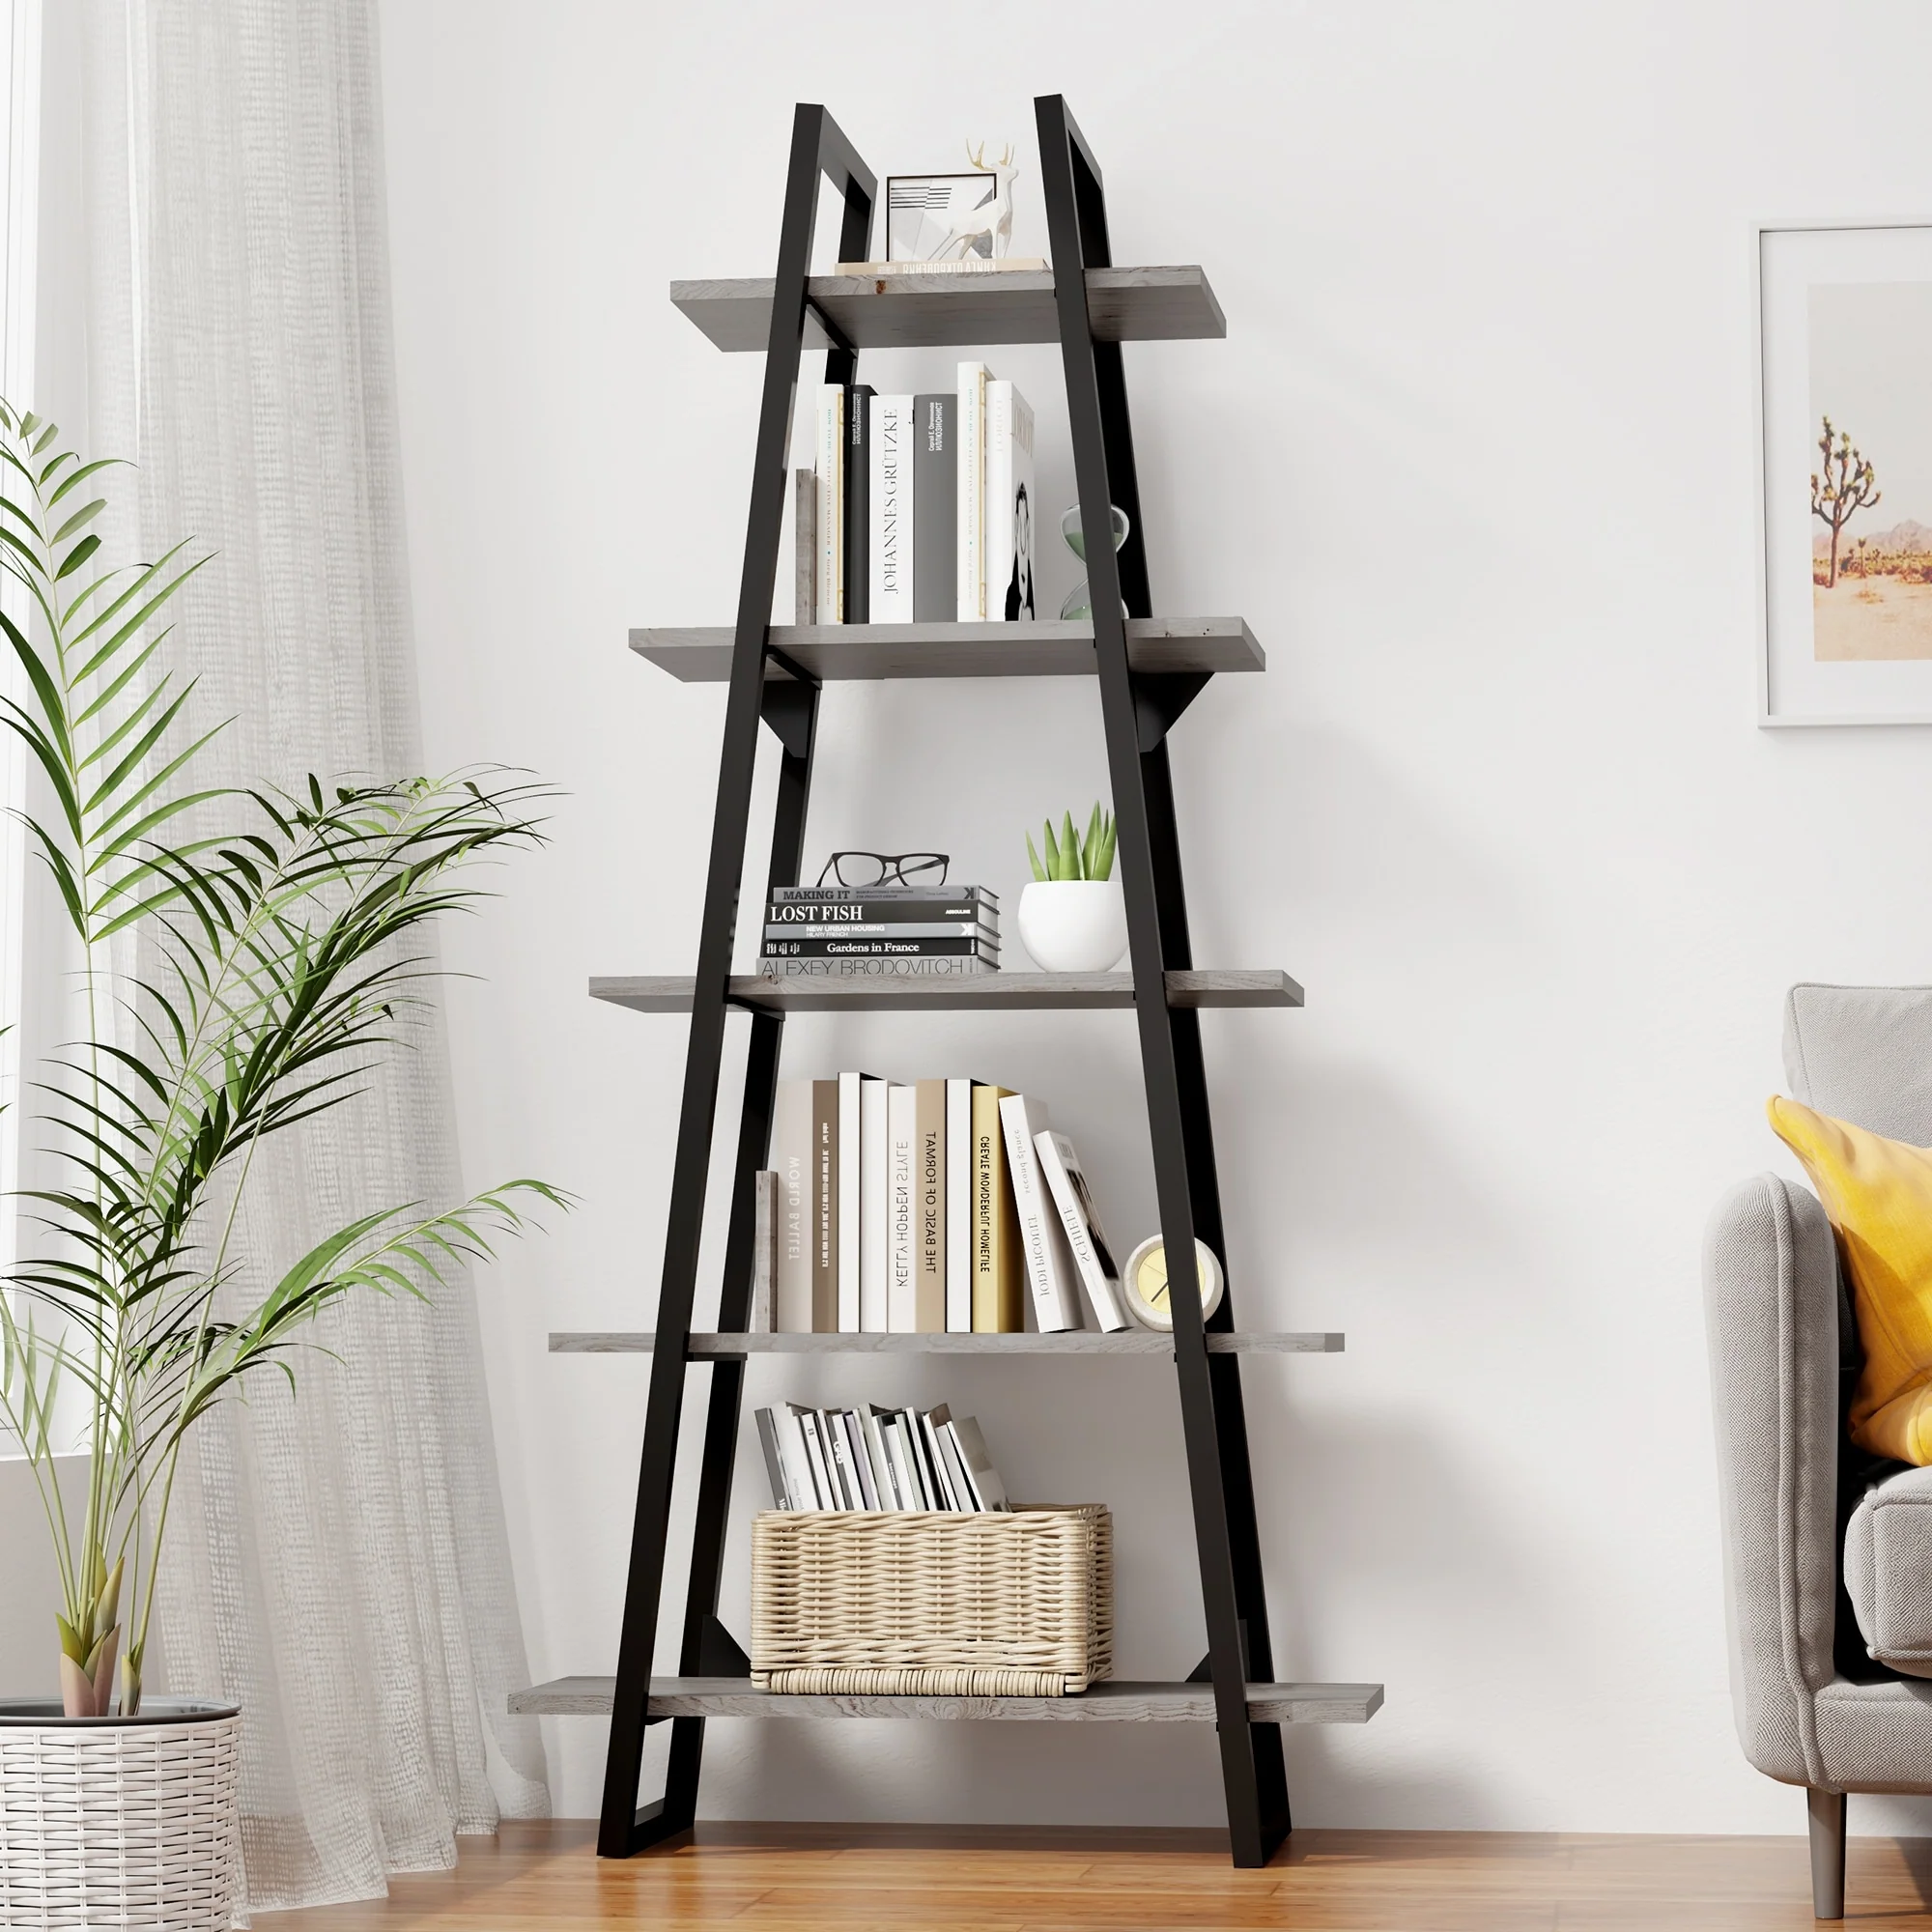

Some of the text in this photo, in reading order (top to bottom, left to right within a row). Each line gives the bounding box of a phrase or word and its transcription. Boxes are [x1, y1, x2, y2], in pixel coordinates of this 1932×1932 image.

[882, 409, 898, 594] JOHANNES GRÜTZKE
[783, 890, 850, 900] MAKING IT
[771, 905, 863, 922] LOST FISH
[827, 942, 920, 953] Gardens in France
[761, 959, 835, 976] ALEXEY
[840, 958, 963, 975] BRODOVITCH
